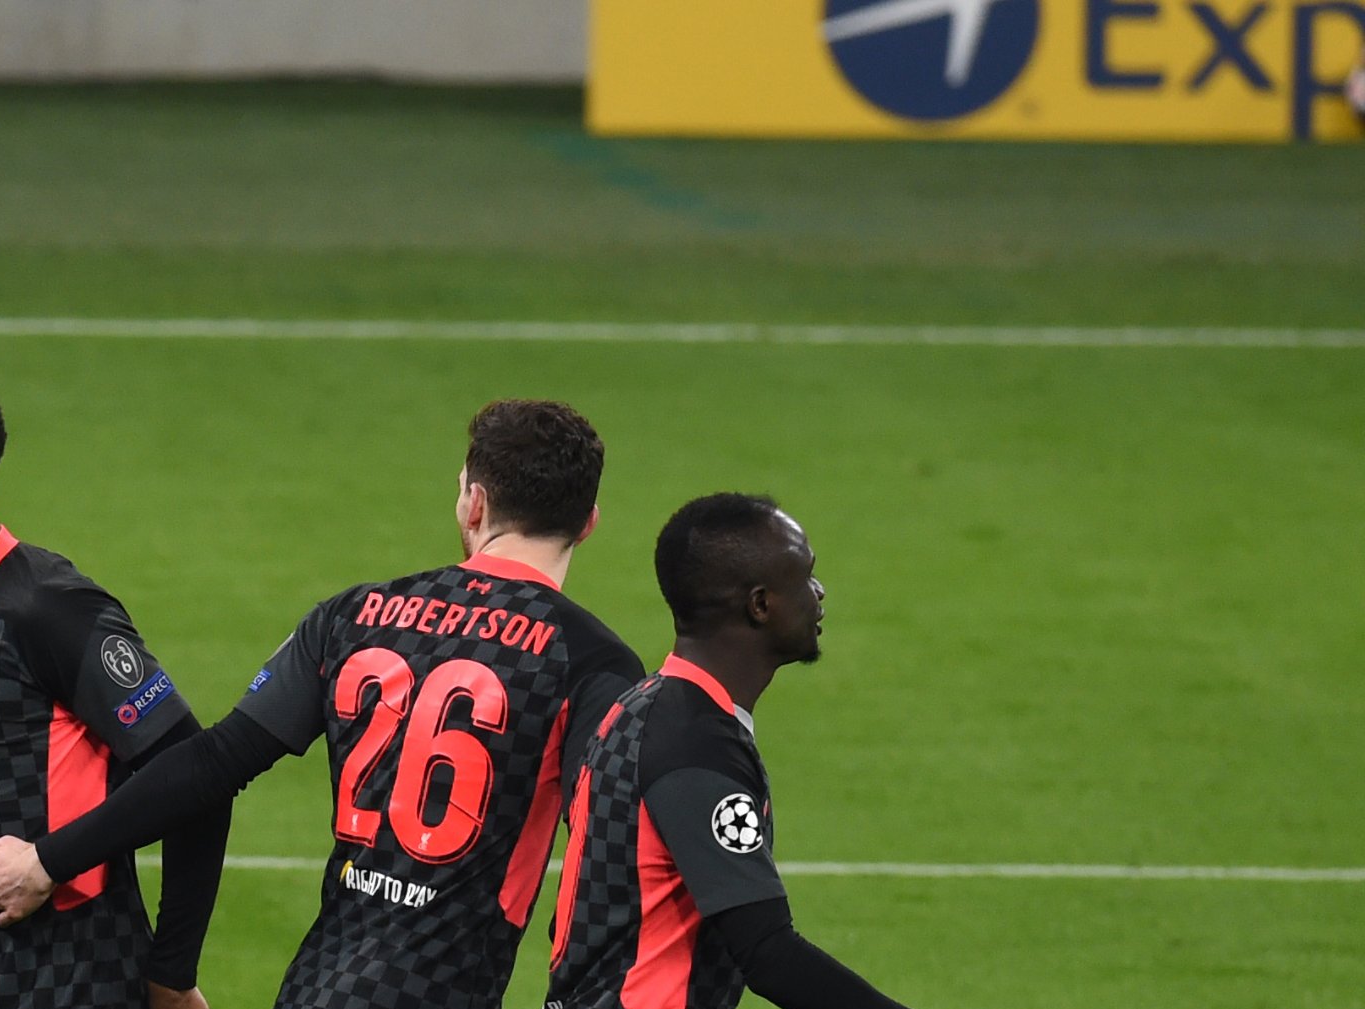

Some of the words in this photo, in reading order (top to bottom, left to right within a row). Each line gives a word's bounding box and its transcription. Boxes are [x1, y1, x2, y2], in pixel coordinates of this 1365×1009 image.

[356, 591, 556, 656] ROBERTSON
[121, 660, 132, 673] 6
[134, 675, 171, 711] RESPECT
[334, 647, 509, 865] 26
[345, 866, 385, 896] RIGHT
[384, 876, 403, 904] TO
